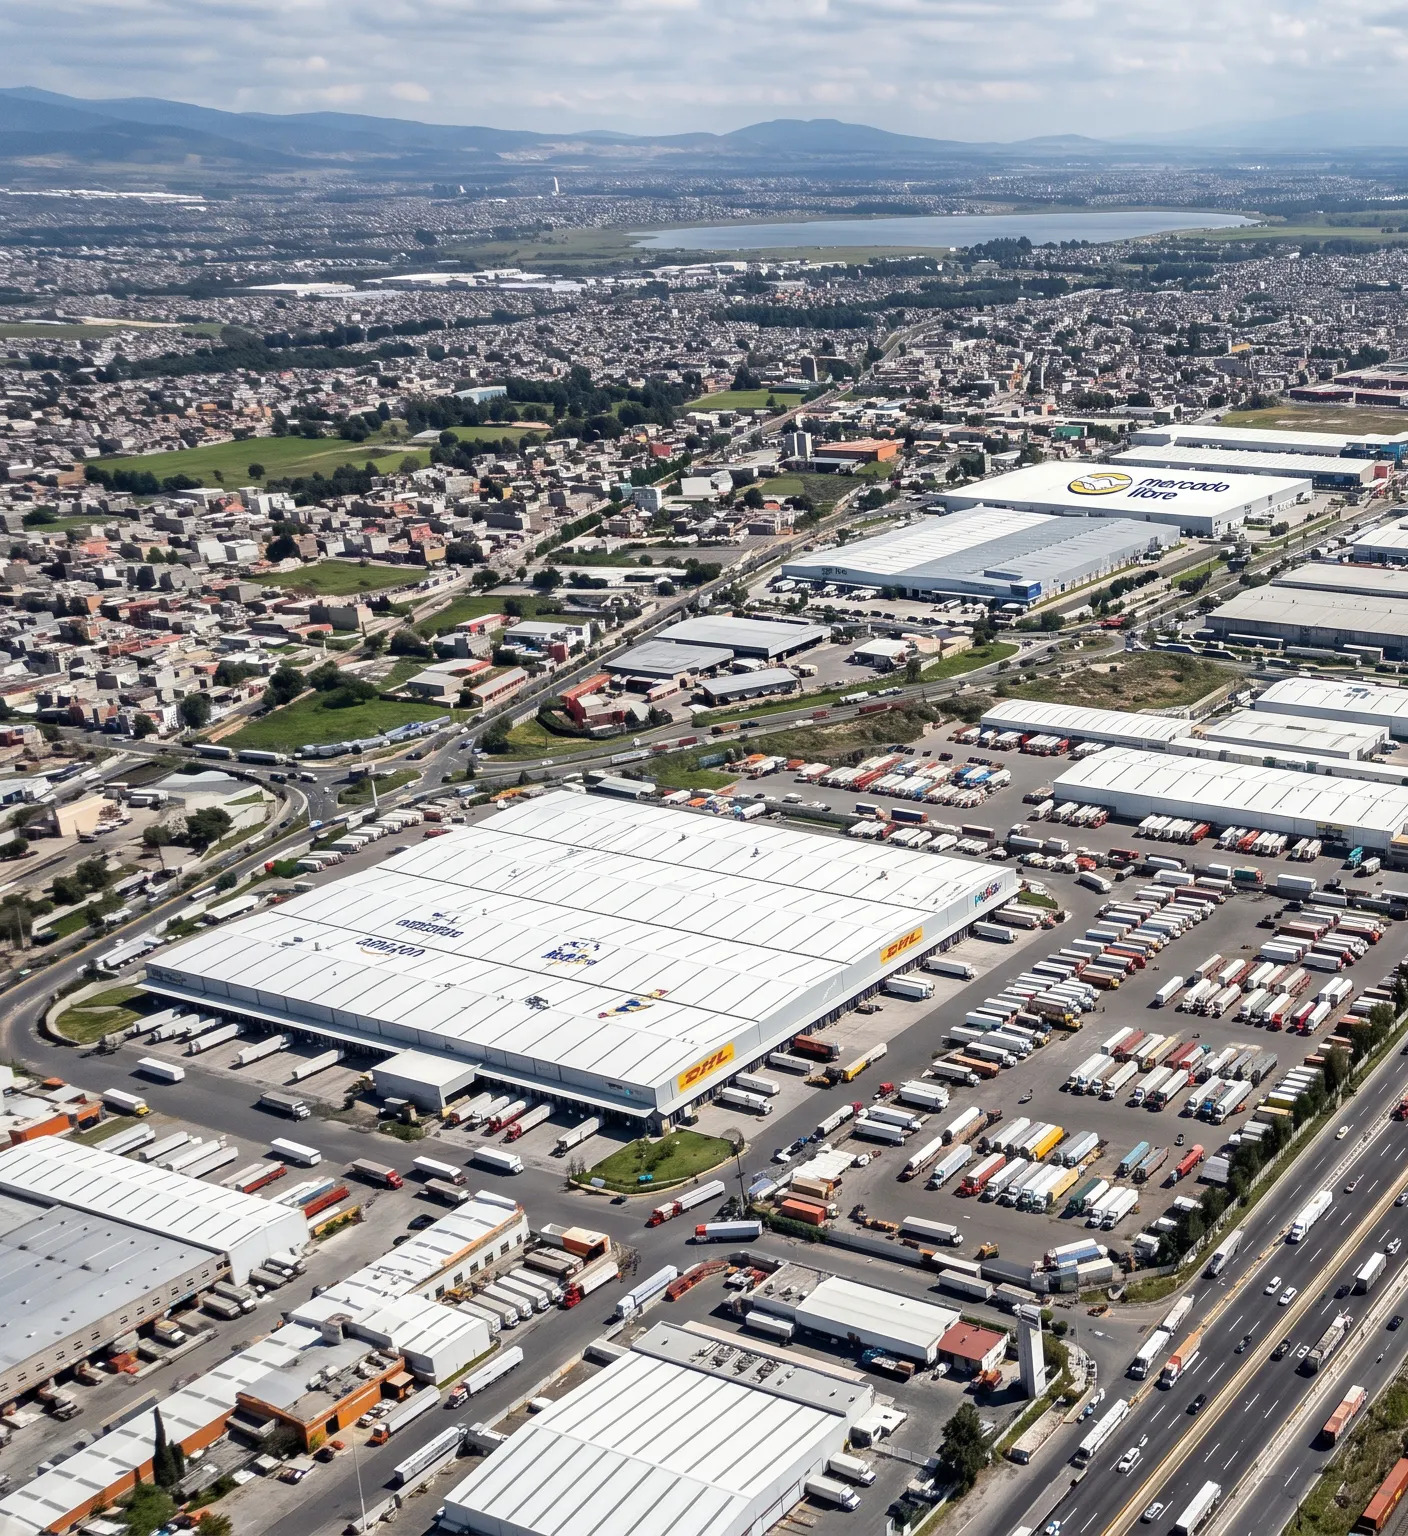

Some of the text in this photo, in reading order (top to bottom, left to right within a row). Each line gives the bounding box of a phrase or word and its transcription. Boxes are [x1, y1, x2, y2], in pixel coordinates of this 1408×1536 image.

[1139, 478, 1230, 492] mercado
[886, 932, 920, 957] DHL
[685, 1050, 729, 1085] DHL
